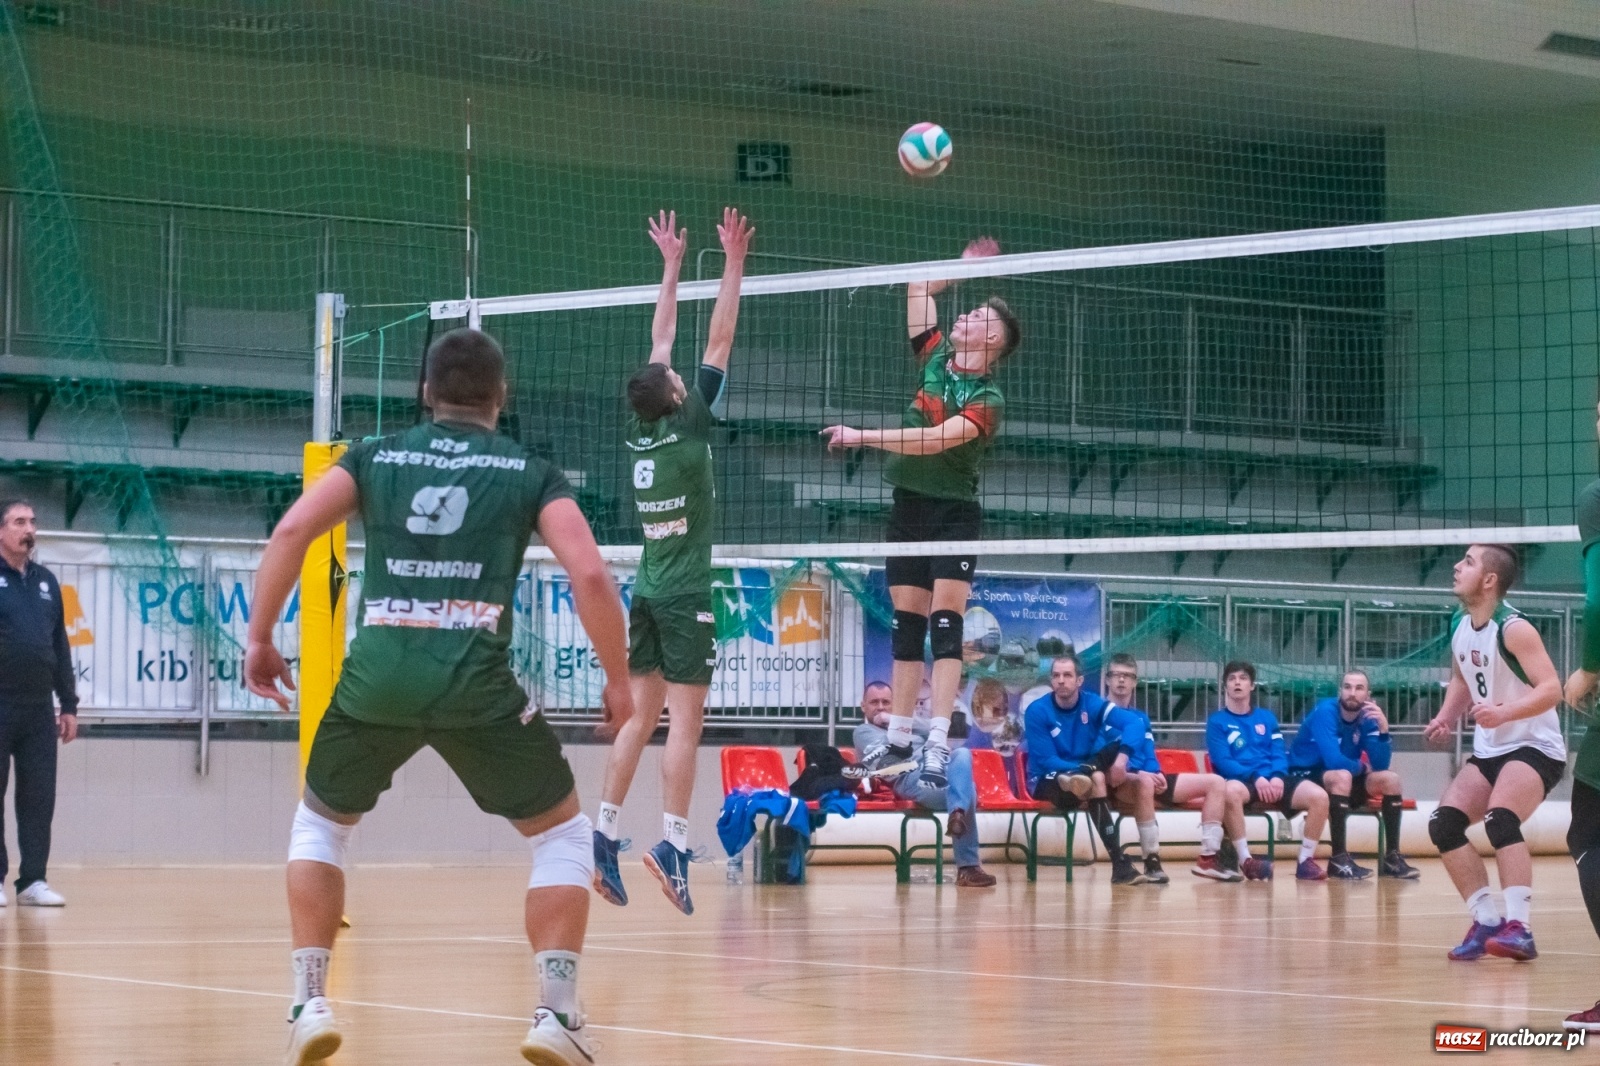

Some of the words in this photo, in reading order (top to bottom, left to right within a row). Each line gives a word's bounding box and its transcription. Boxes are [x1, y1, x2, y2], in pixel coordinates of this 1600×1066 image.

[746, 157, 778, 177] D
[633, 459, 655, 490] 6
[406, 486, 469, 535] 9
[1475, 672, 1488, 698] 8
